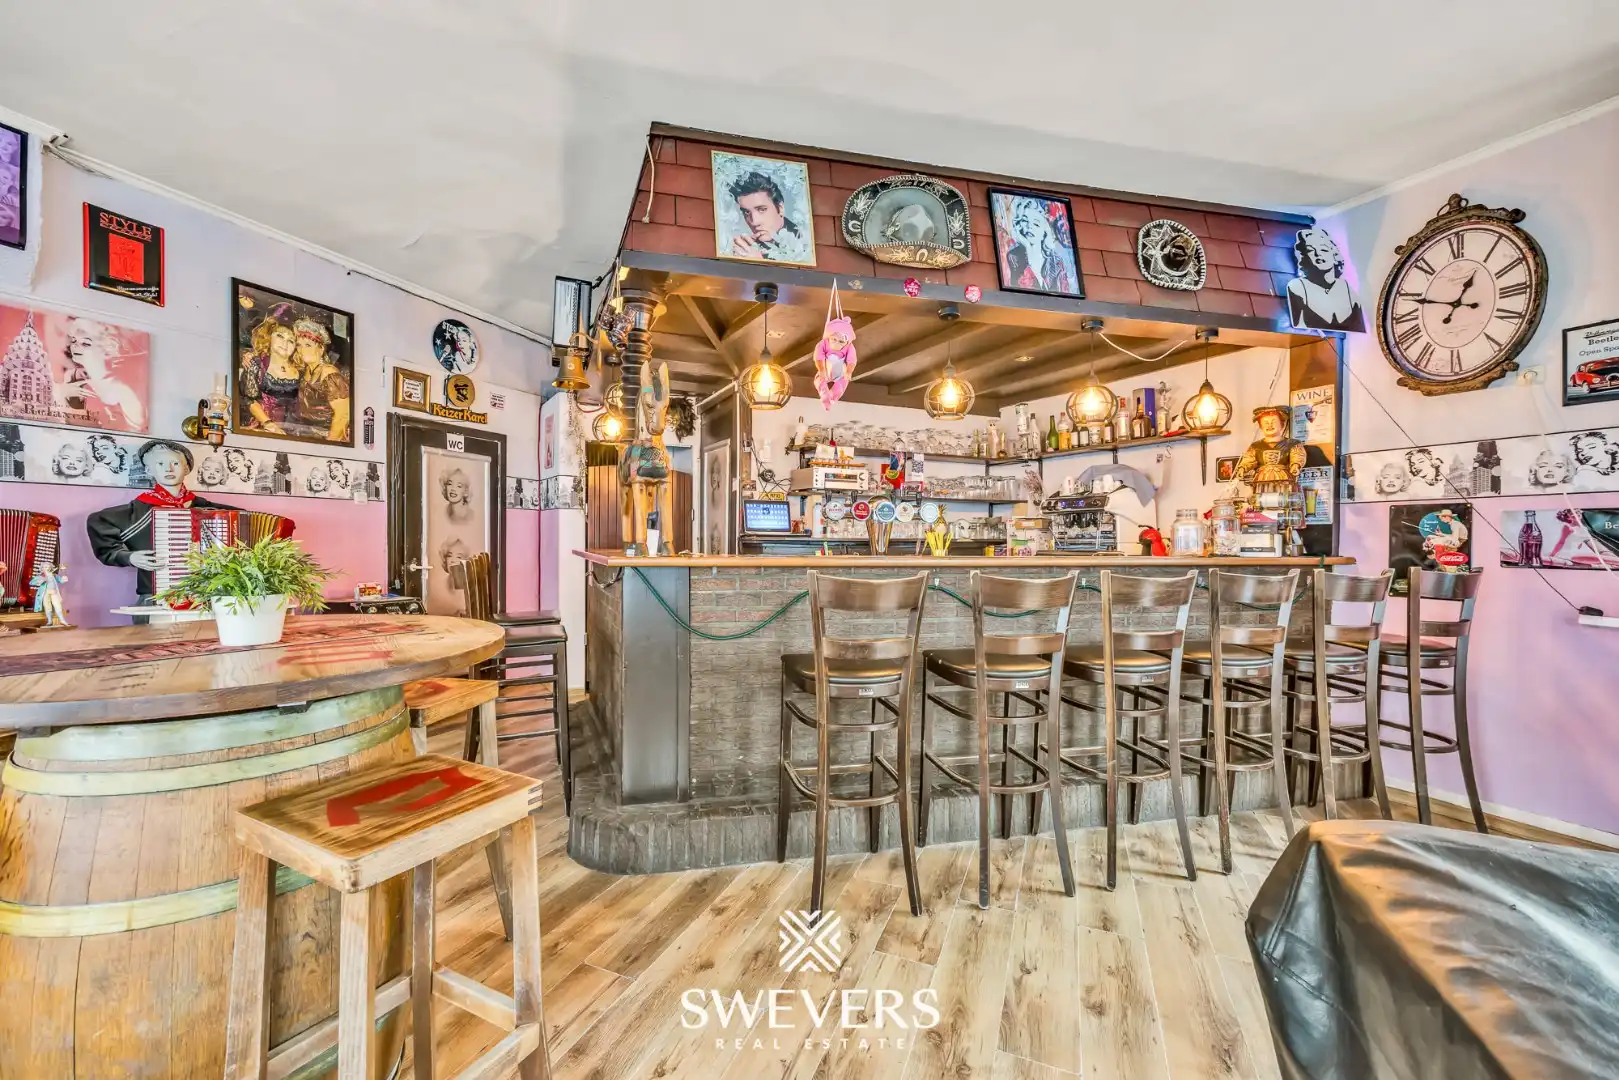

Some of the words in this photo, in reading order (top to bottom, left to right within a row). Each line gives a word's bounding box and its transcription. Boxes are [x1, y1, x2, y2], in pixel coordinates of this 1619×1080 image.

[99, 211, 152, 238] STYLE
[1296, 388, 1329, 401] WINE
[447, 440, 464, 451] WC
